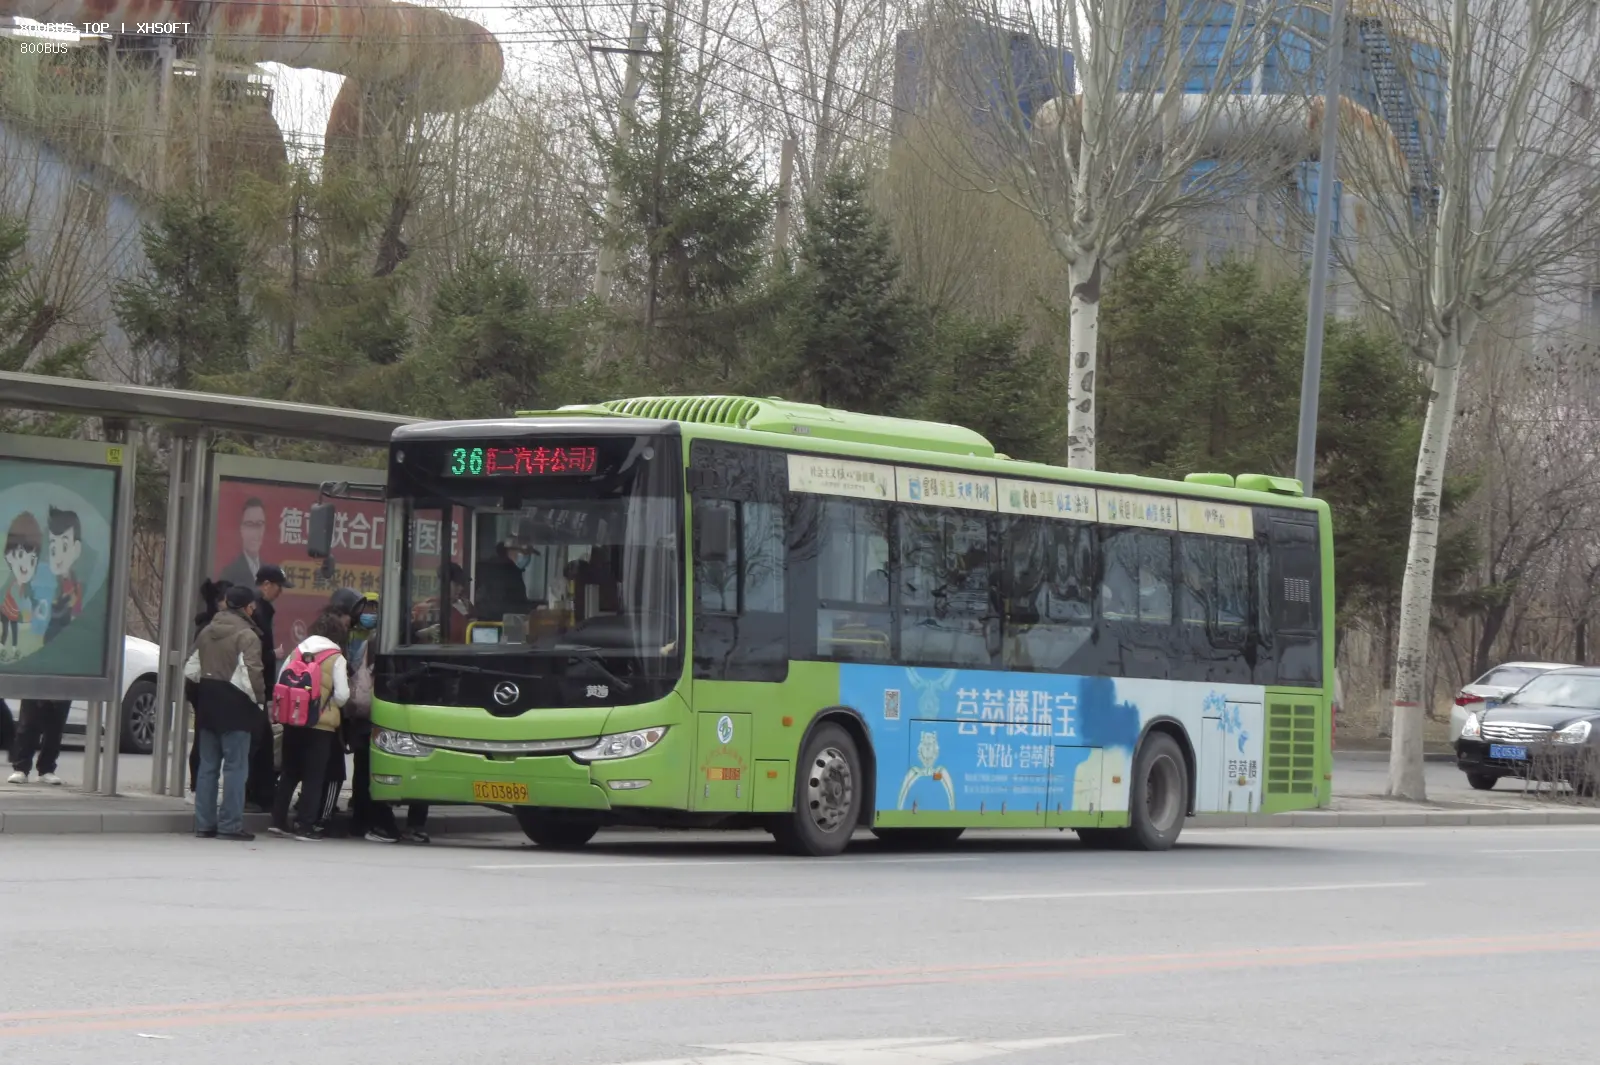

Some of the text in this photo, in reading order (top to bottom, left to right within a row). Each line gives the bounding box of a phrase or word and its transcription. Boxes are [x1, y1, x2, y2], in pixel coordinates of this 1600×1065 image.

[451, 447, 483, 475] 36
[585, 684, 609, 698] 黄海
[955, 686, 1079, 738] 荟萃楼珠宝
